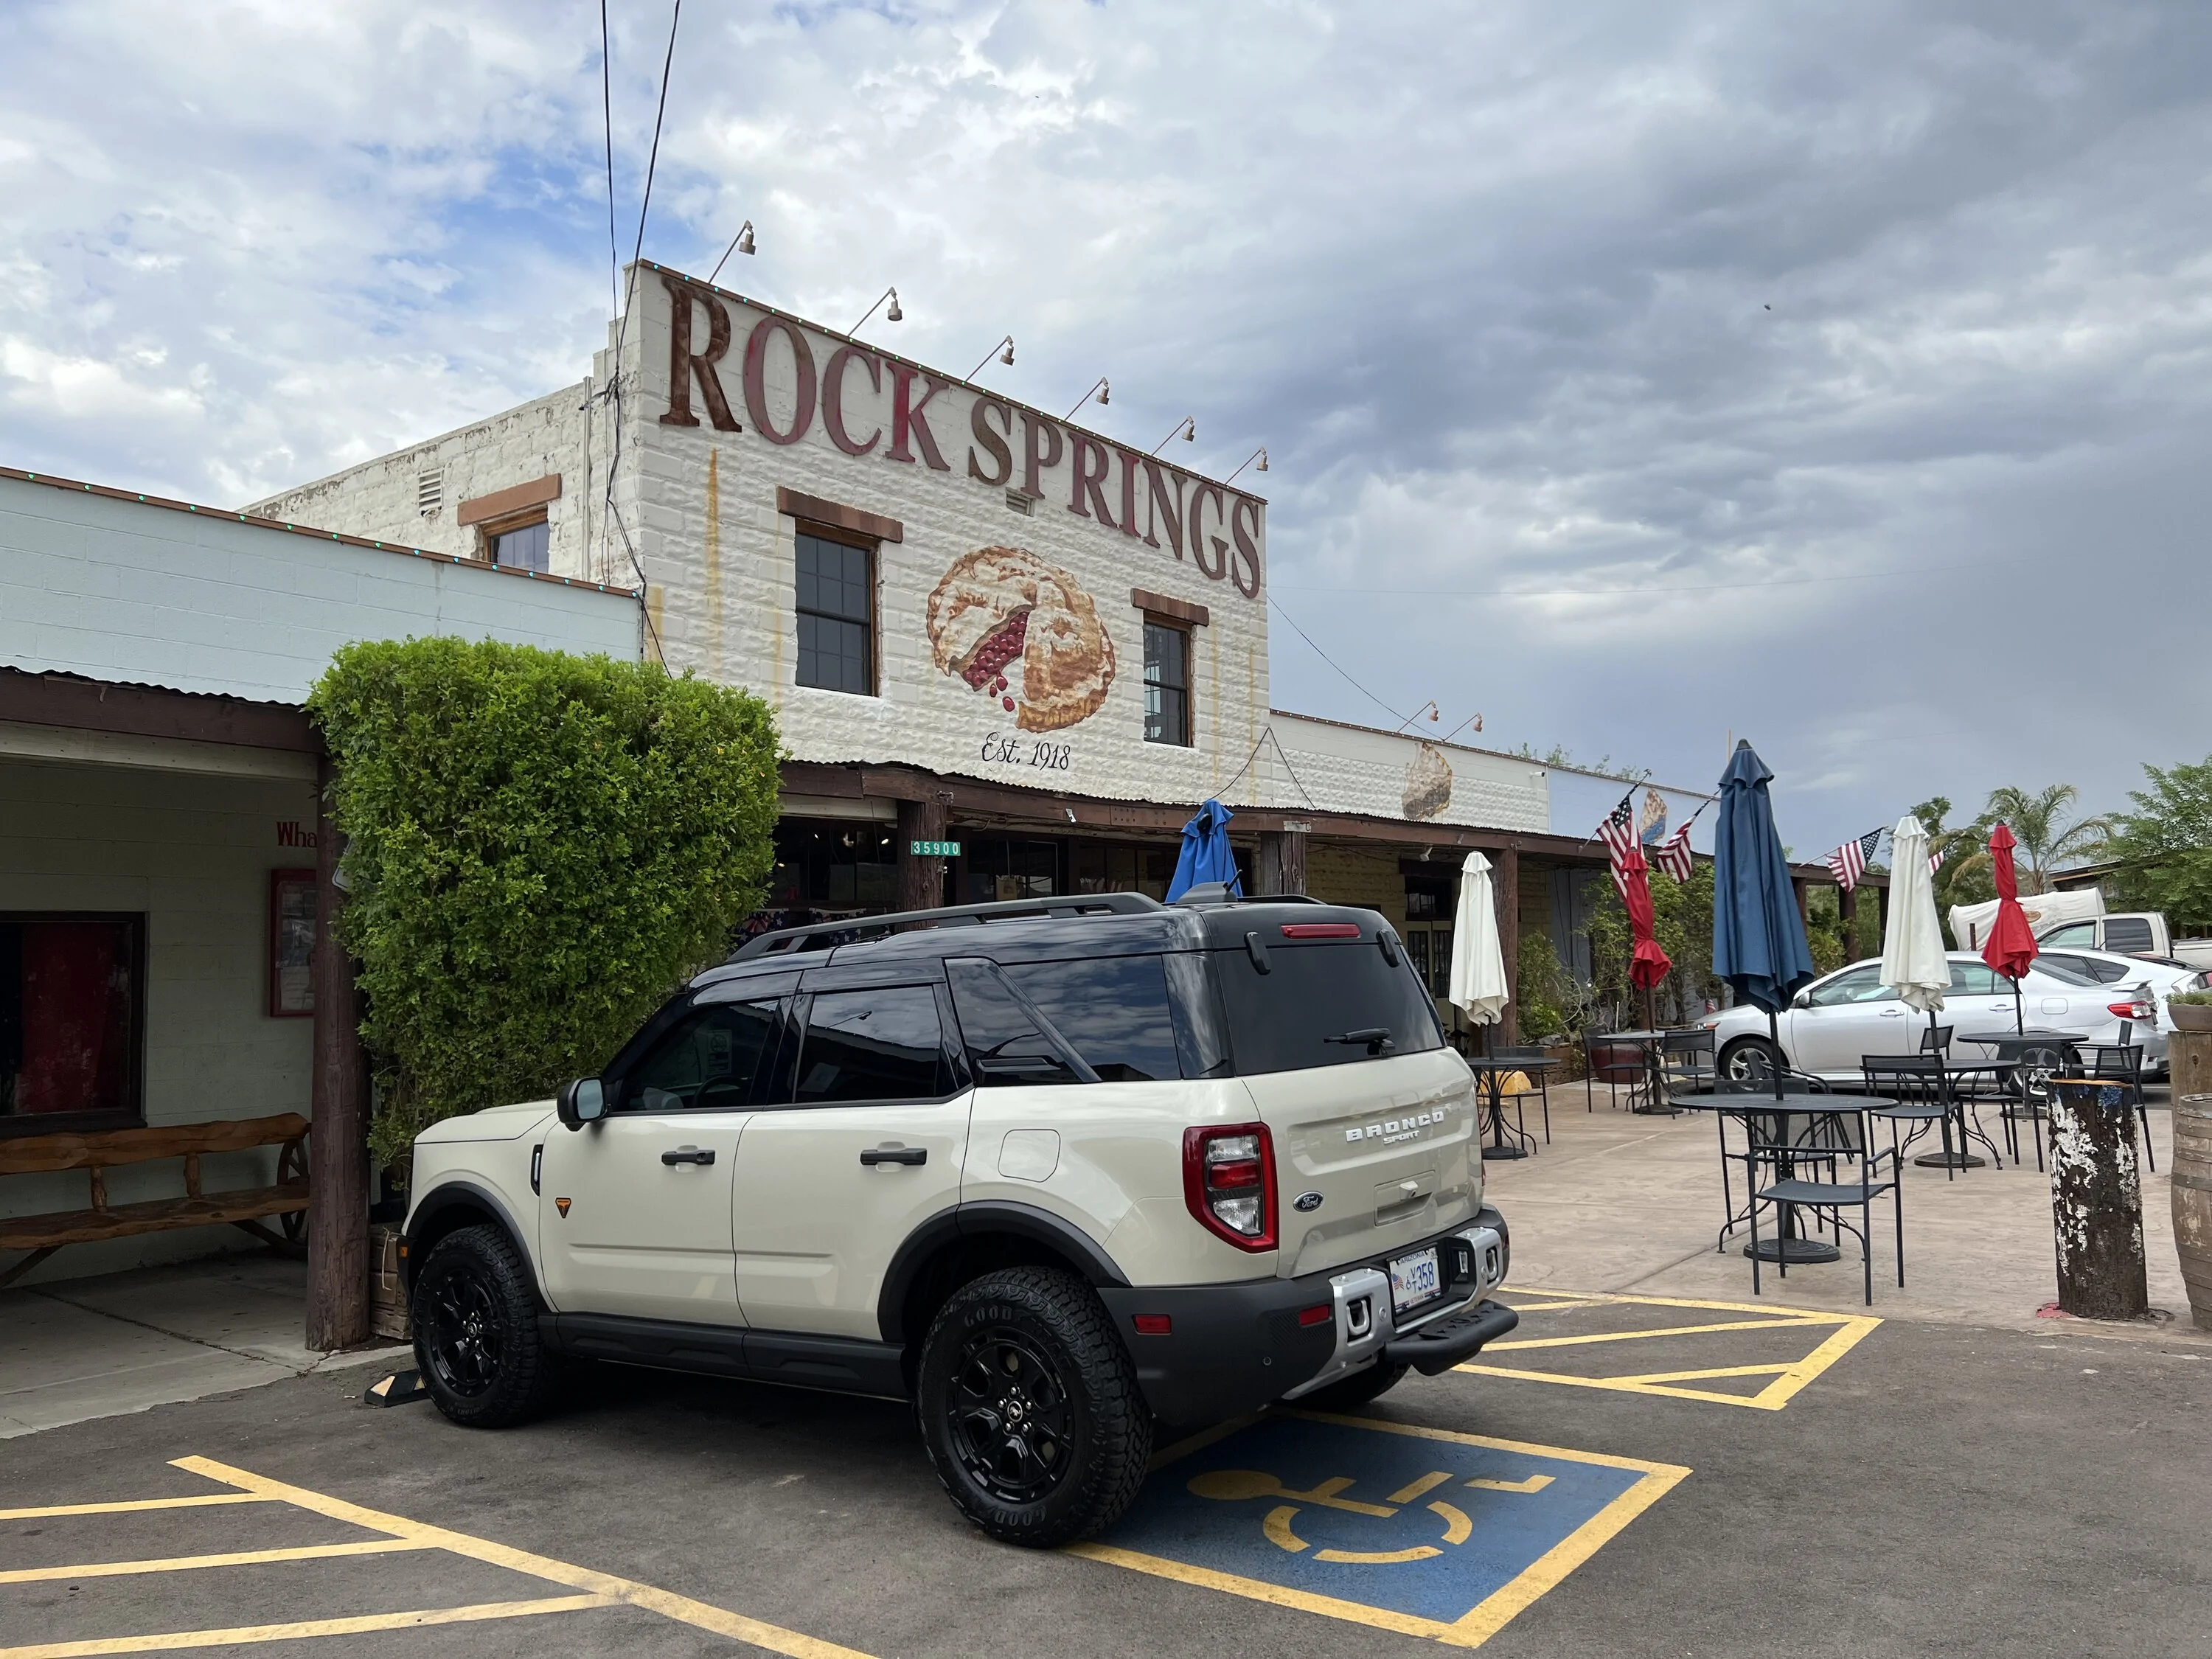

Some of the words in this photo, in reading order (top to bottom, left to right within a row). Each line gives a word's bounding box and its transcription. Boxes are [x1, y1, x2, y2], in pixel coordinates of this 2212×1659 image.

[659, 275, 950, 470] ROCK
[967, 394, 1260, 599] SPRINGS
[981, 731, 1020, 764] Est.
[1027, 741, 1070, 771] 1918
[914, 841, 959, 854] 35900
[1346, 1111, 1444, 1142] BRONCO
[1382, 1131, 1419, 1145] SPORT
[1400, 1251, 1425, 1264] ARIZONA
